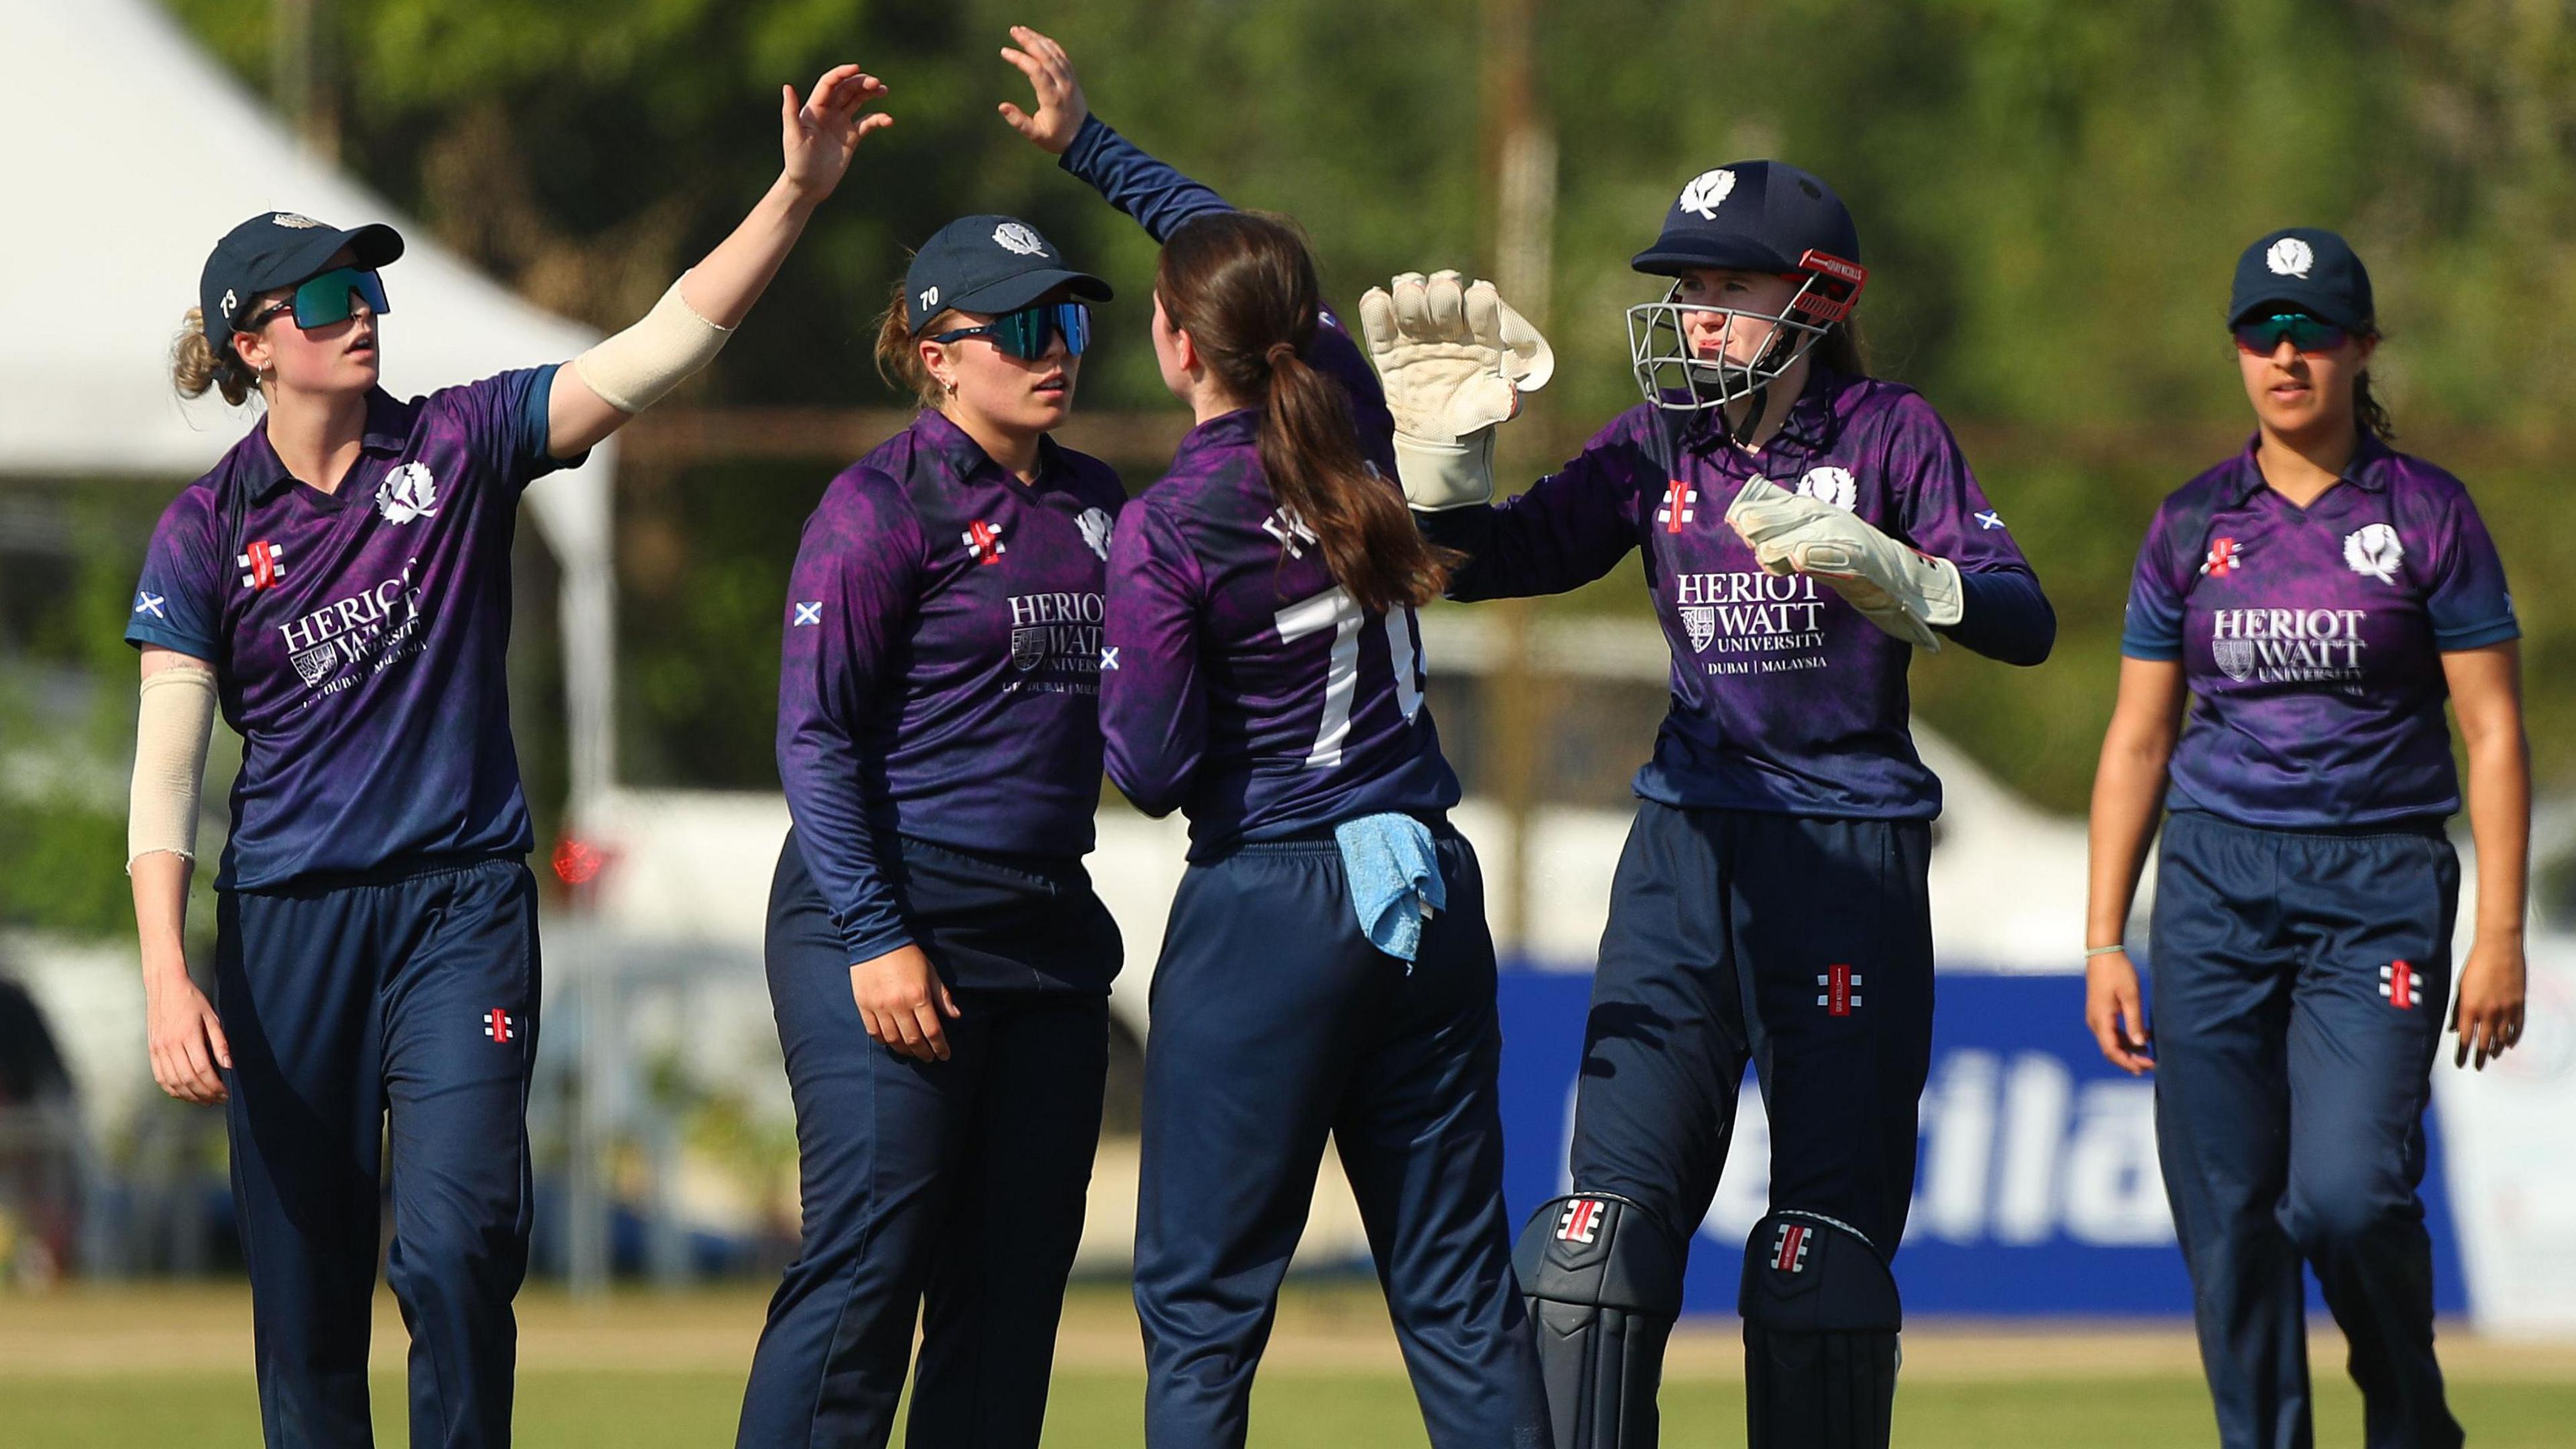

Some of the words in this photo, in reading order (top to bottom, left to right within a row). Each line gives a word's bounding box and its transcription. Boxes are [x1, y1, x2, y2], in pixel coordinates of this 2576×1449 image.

[920, 286, 938, 311] 70
[1677, 572, 1818, 604] HERIOT
[1007, 592, 1106, 626] HERIO
[1715, 602, 1825, 636] WATT
[2213, 608, 2367, 639] HERIOT
[1048, 625, 1103, 655] WAT
[1717, 632, 1825, 654] UNIVERSITY
[2256, 638, 2368, 667] WATT
[1708, 661, 1748, 675] DUBAI
[1762, 656, 1827, 674] MALAYSIA
[2258, 667, 2363, 683] UNIVERSITY
